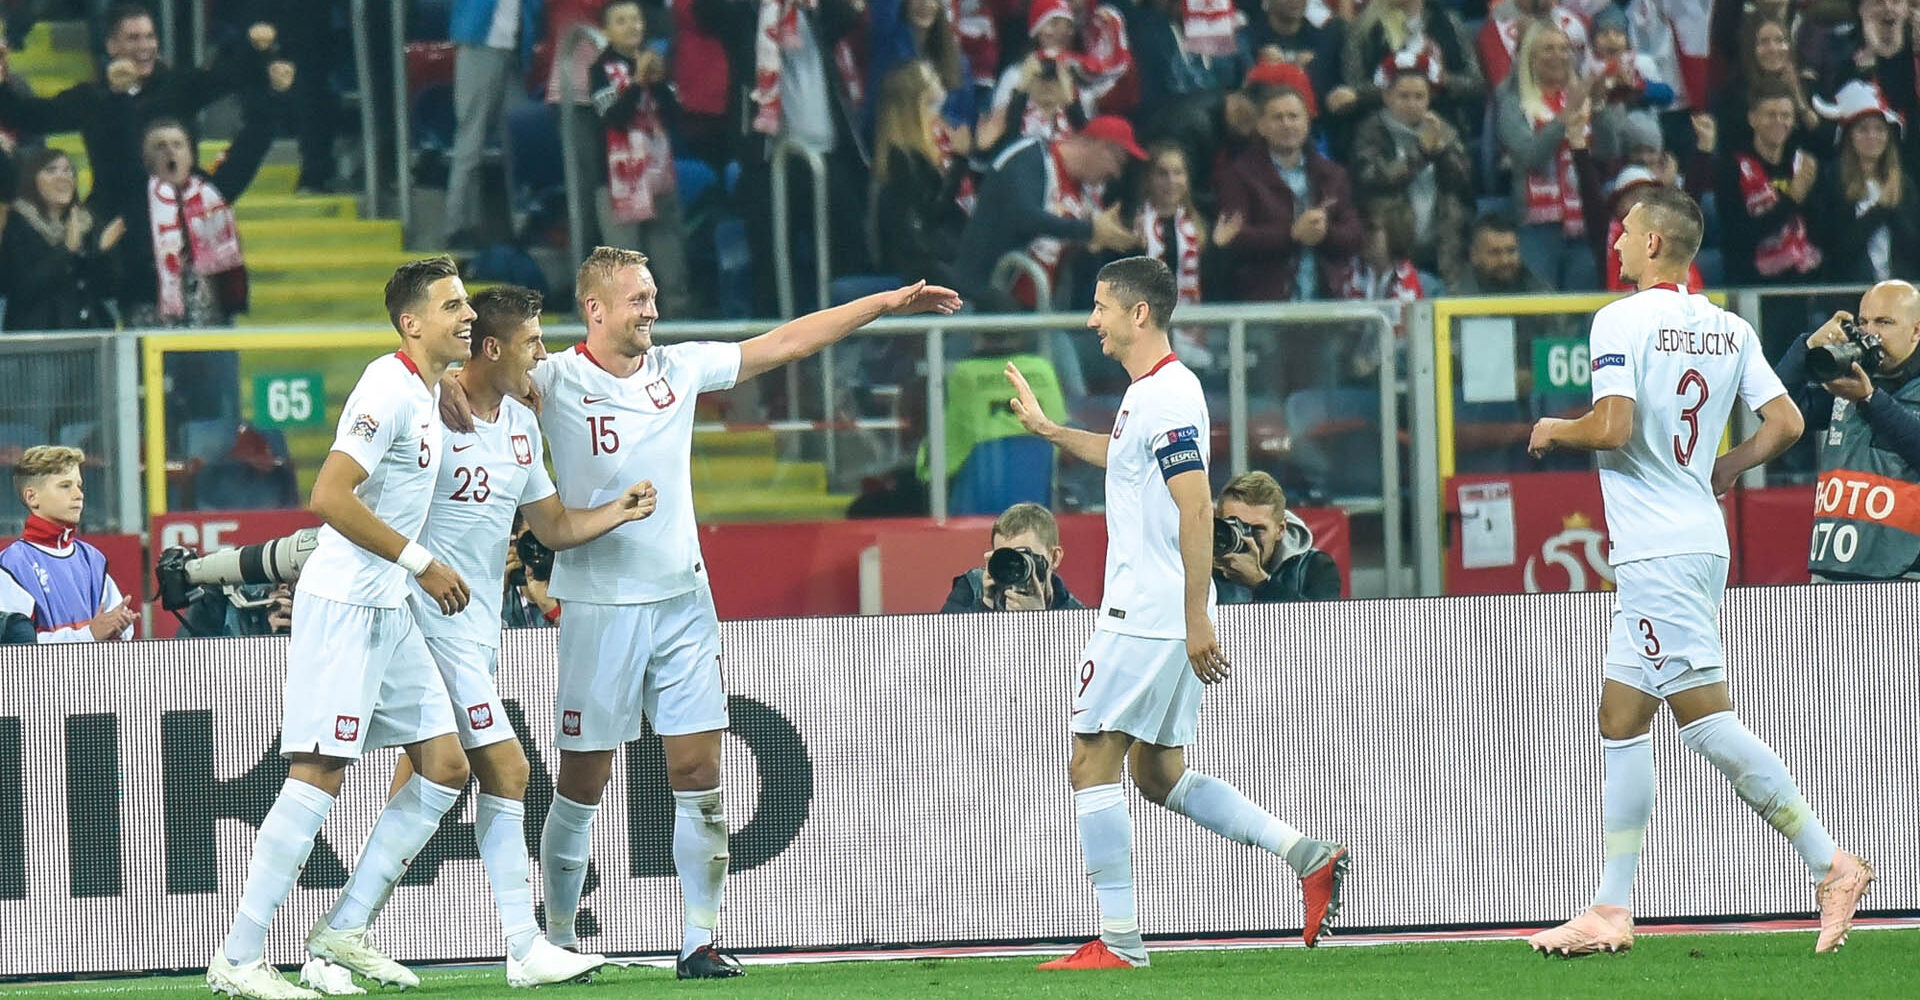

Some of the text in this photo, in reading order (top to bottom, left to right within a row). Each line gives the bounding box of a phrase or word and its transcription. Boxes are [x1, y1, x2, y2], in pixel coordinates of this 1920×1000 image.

[1548, 344, 1590, 387] 66
[267, 379, 312, 422] 65
[1674, 368, 1709, 466] 3
[418, 438, 431, 469] 5
[586, 416, 619, 456] 15
[449, 466, 491, 503] 23
[1639, 618, 1660, 656] 3
[1078, 660, 1094, 698] 9
